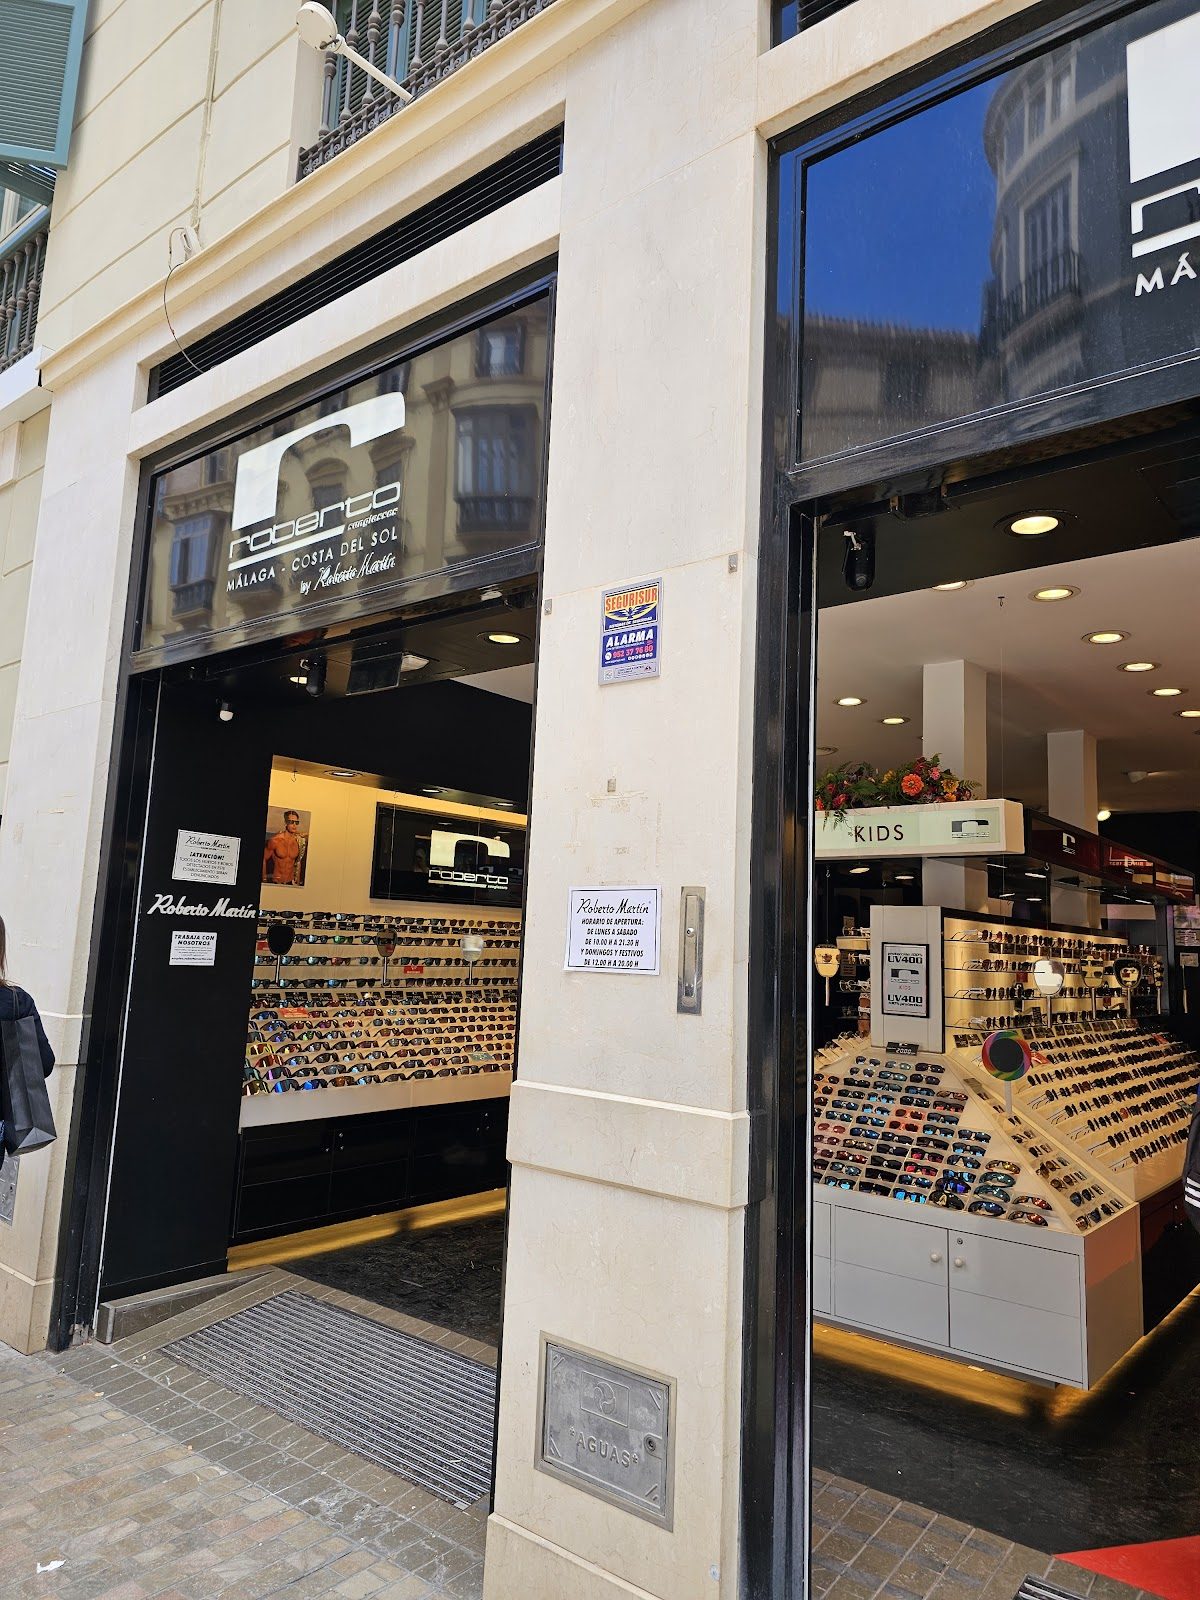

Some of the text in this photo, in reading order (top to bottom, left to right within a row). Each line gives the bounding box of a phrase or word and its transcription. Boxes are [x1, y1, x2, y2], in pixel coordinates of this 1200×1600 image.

[229, 481, 401, 558] roberto
[226, 566, 276, 592] MÁLAGA
[291, 547, 334, 572] COSTA
[340, 536, 364, 557] DEL
[370, 526, 398, 547] SOL
[300, 579, 312, 595] by
[313, 562, 357, 591] Roberto
[605, 587, 658, 612] SEGURISUR
[606, 629, 654, 648] ALARMA
[612, 650, 625, 659] 952
[625, 648, 634, 656] 37
[644, 645, 654, 653] 80
[854, 824, 904, 842] KIDS
[428, 869, 509, 885] roberto
[147, 894, 256, 918] Roberto Martín
[576, 898, 649, 914] Roberto Martín
[614, 918, 644, 926] APERTURA:
[592, 938, 608, 946] 10.00
[585, 948, 613, 956] DOMINGOS
[619, 949, 644, 957] FESTIVOS
[887, 955, 923, 964] UV400
[583, 958, 591, 966] DE
[887, 994, 923, 1004] UV400
[576, 1431, 631, 1468] AGUAS
